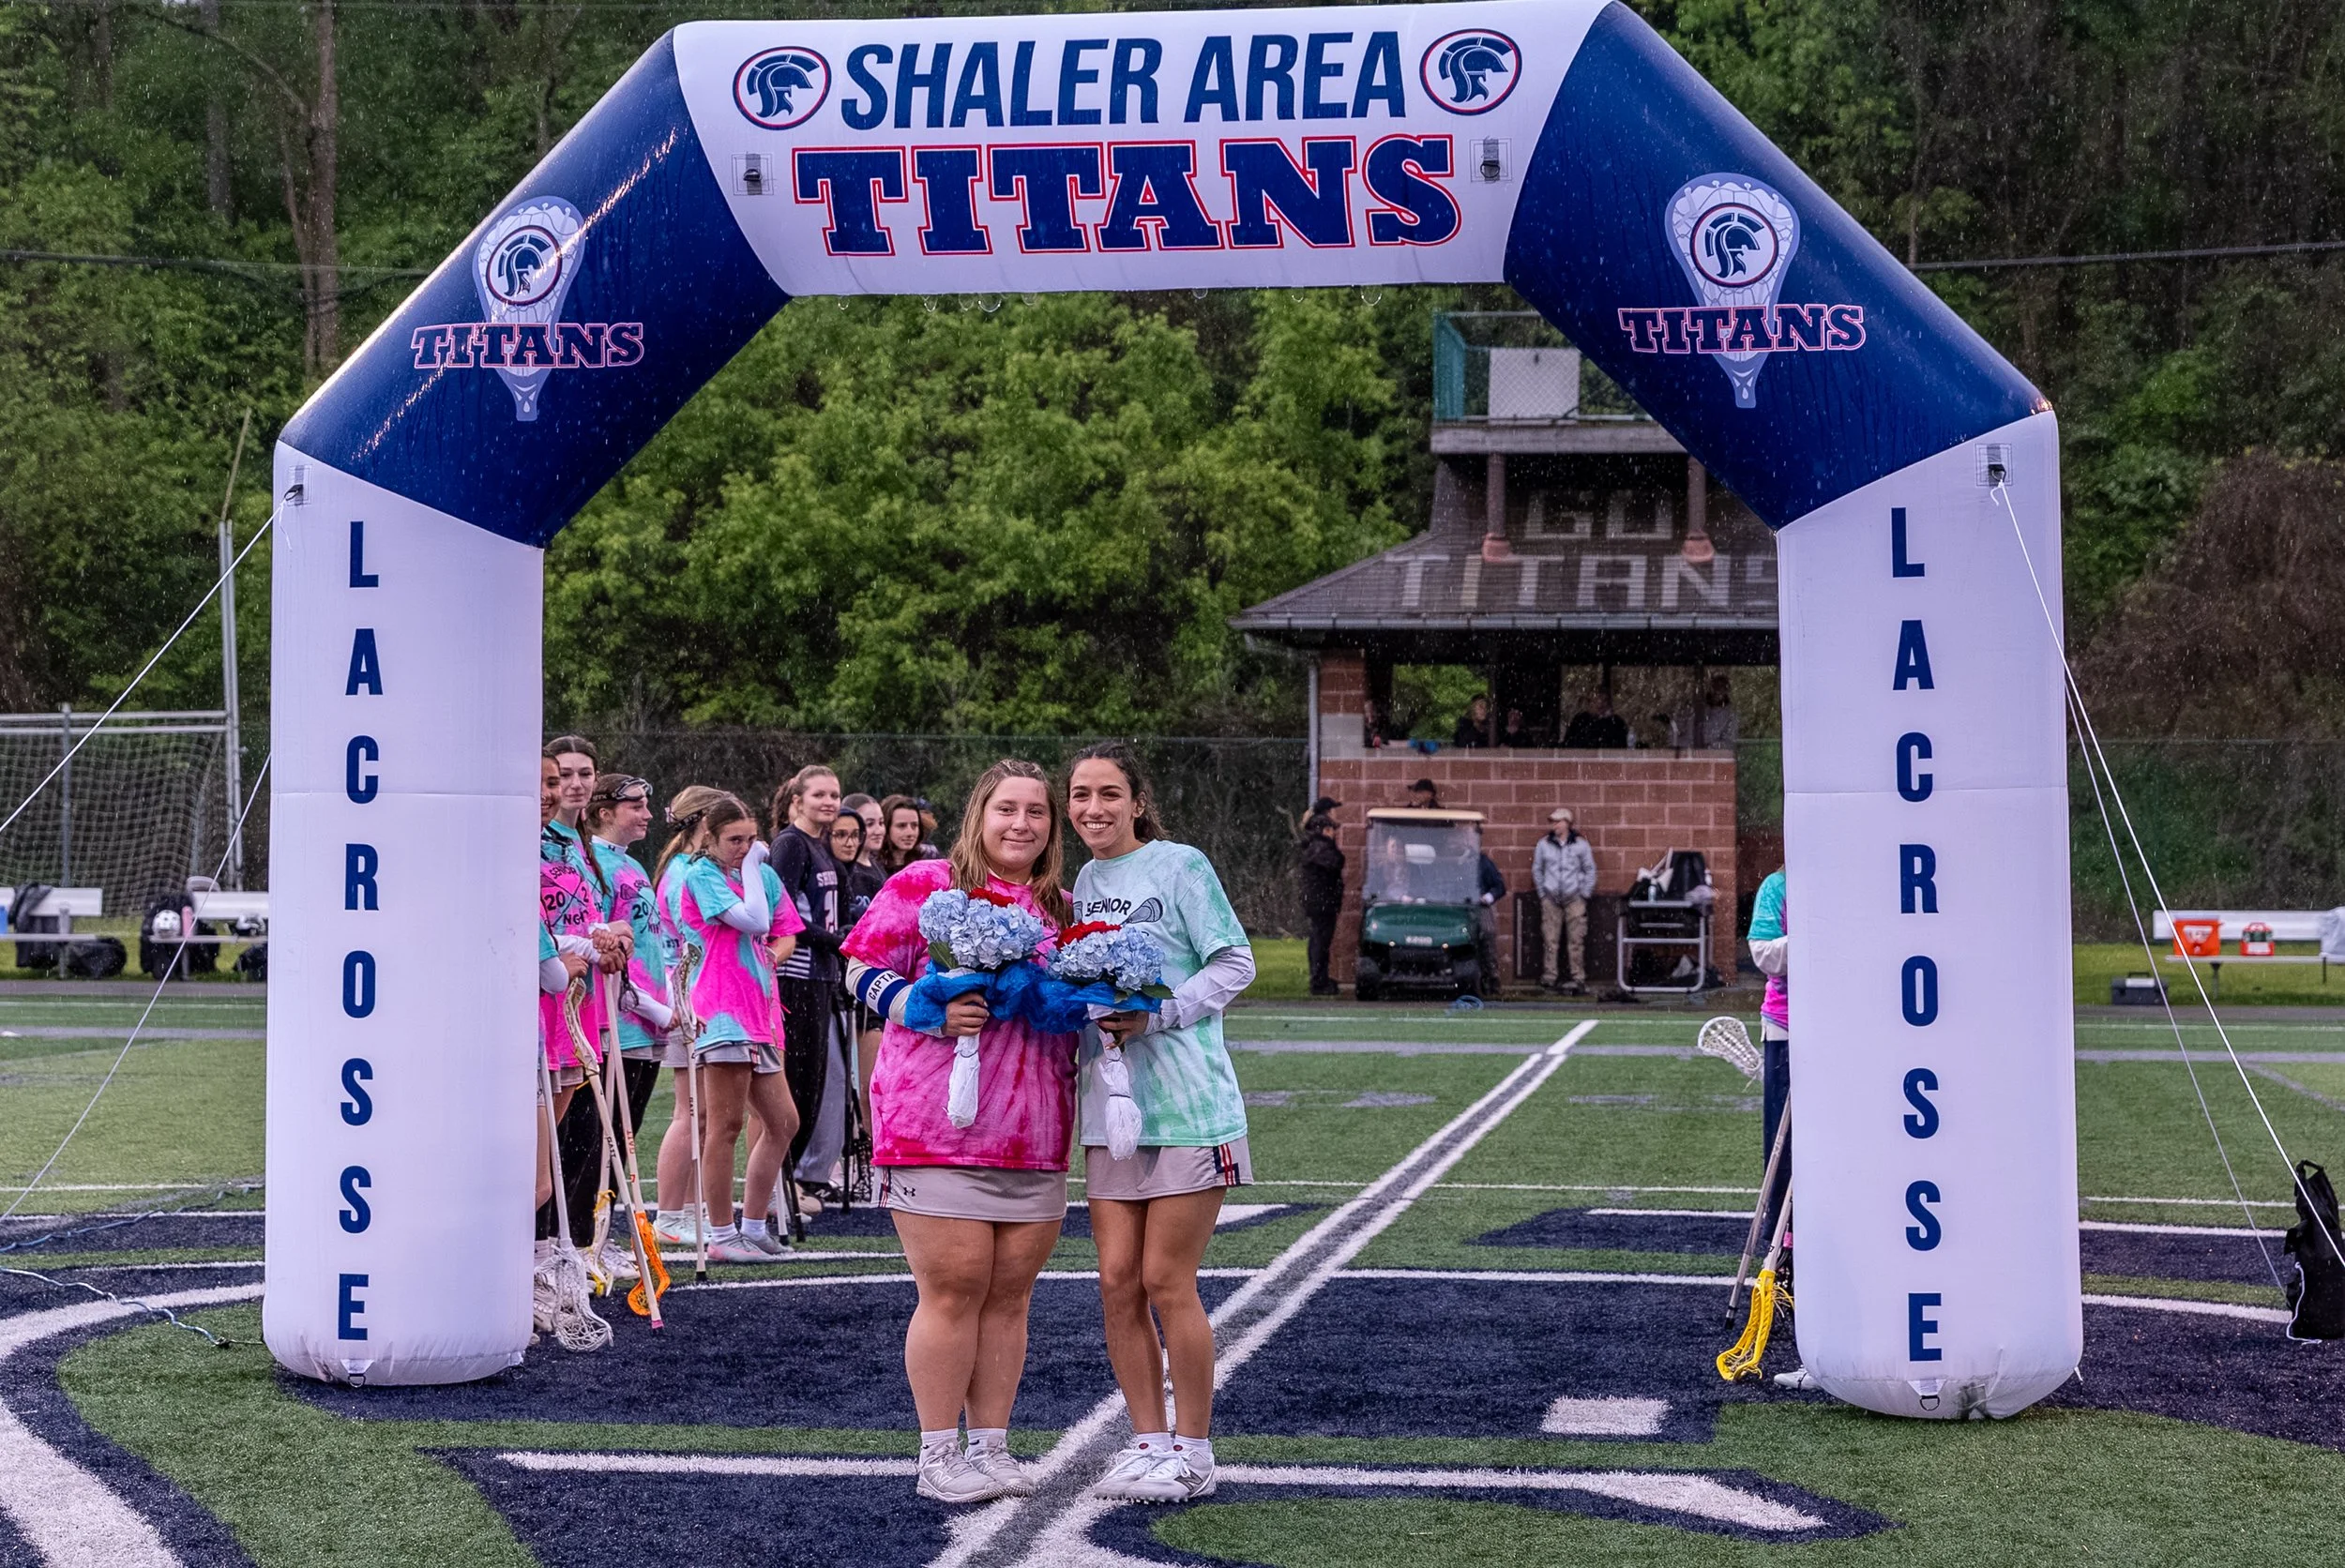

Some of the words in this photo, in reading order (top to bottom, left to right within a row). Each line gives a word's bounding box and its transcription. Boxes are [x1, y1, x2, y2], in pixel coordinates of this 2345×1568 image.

[840, 38, 1163, 130] SHALER
[1184, 31, 1407, 123] AREA
[792, 133, 1463, 257] TITANS
[411, 322, 645, 369] TITANS
[1617, 304, 1867, 354] TITANS
[544, 891, 566, 911] 20
[632, 901, 649, 920] 20
[1084, 897, 1132, 916] SENIOR
[338, 520, 384, 1341] LACROSSE
[1890, 506, 1943, 1362] LACROSSE
[868, 971, 900, 1001] CAPTAI
